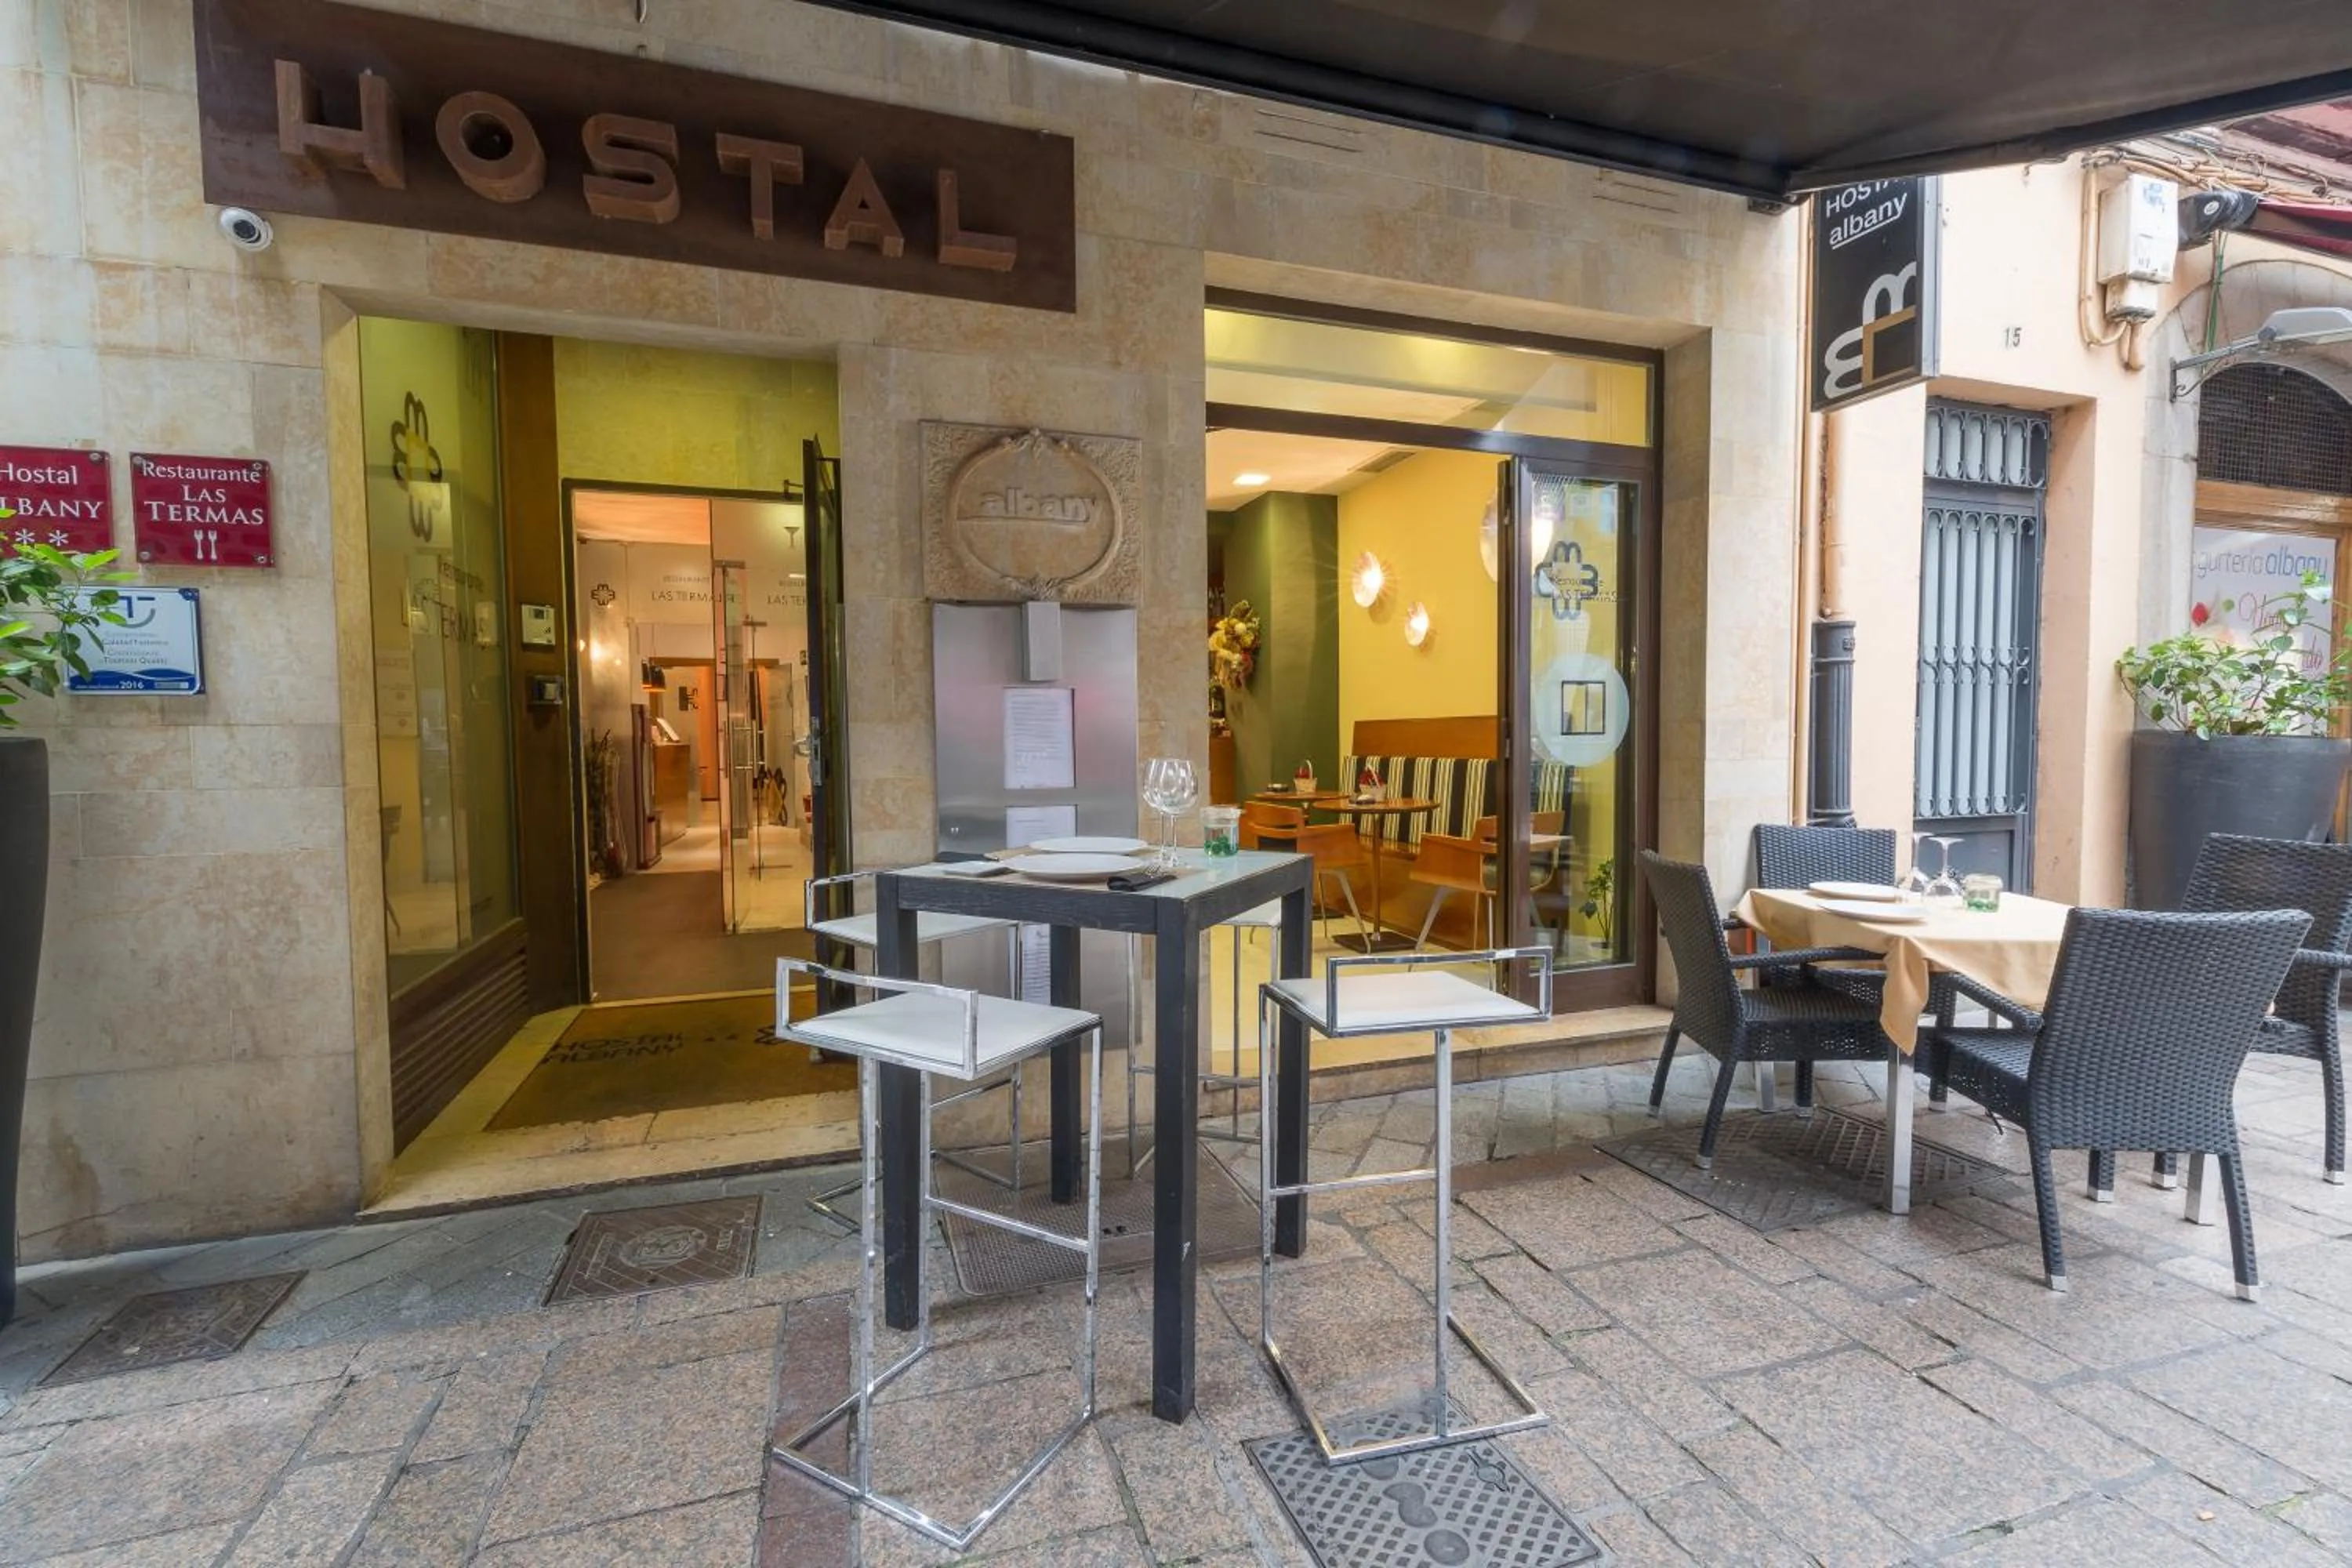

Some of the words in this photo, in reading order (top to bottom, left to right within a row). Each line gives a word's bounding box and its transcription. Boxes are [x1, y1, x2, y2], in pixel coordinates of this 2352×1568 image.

[274, 58, 1018, 272] HOSTAL
[1826, 180, 1906, 218] HOS
[1829, 193, 1907, 250] albany
[2003, 325, 2023, 350] 15
[0, 463, 79, 485] Hostal
[142, 461, 261, 484] Restaurante
[183, 484, 227, 503] LAS
[979, 487, 1095, 524] albany
[0, 496, 104, 519] LBANY
[144, 500, 264, 525] TERMAS
[652, 590, 673, 601] LAS
[119, 680, 144, 689] 2016
